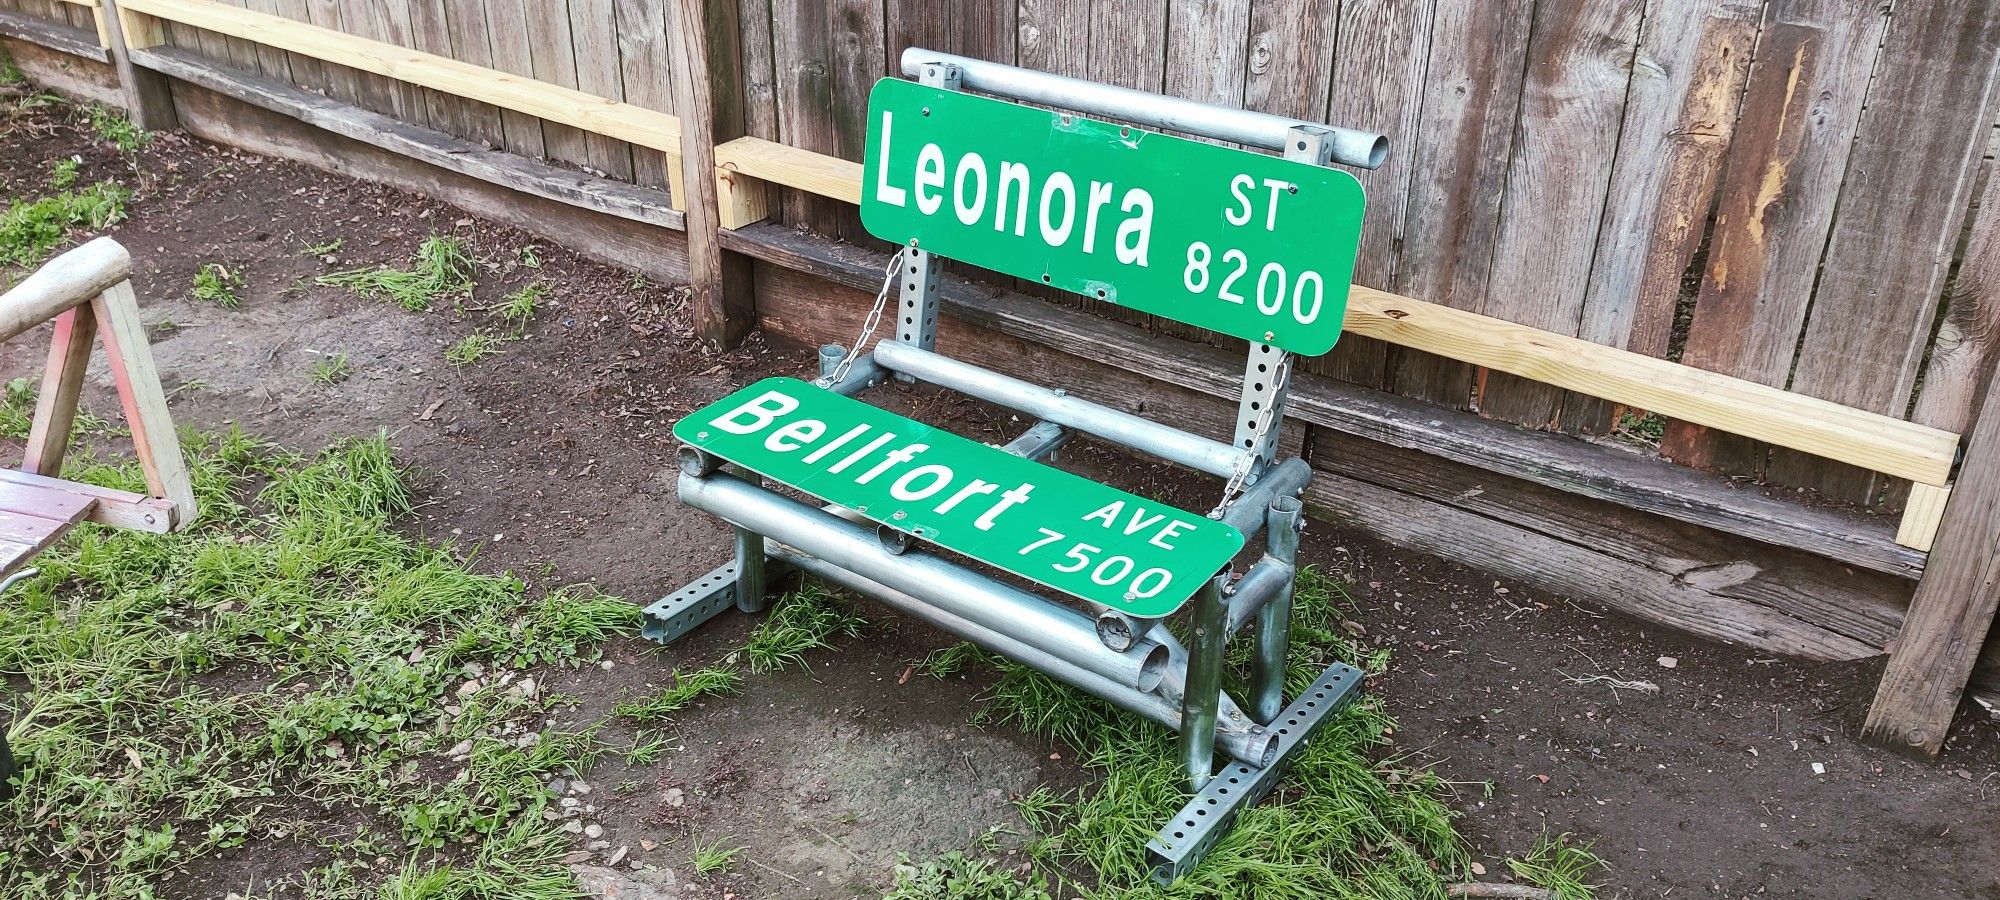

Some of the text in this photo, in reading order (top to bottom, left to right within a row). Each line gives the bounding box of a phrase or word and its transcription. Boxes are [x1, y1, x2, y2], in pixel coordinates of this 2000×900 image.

[876, 111, 1154, 267] Leonora
[1225, 174, 1297, 231] ST
[1183, 241, 1323, 325] 8200
[708, 390, 1036, 531] Bellfort
[1018, 527, 1173, 601] 7500
[1082, 500, 1197, 551] AVE
